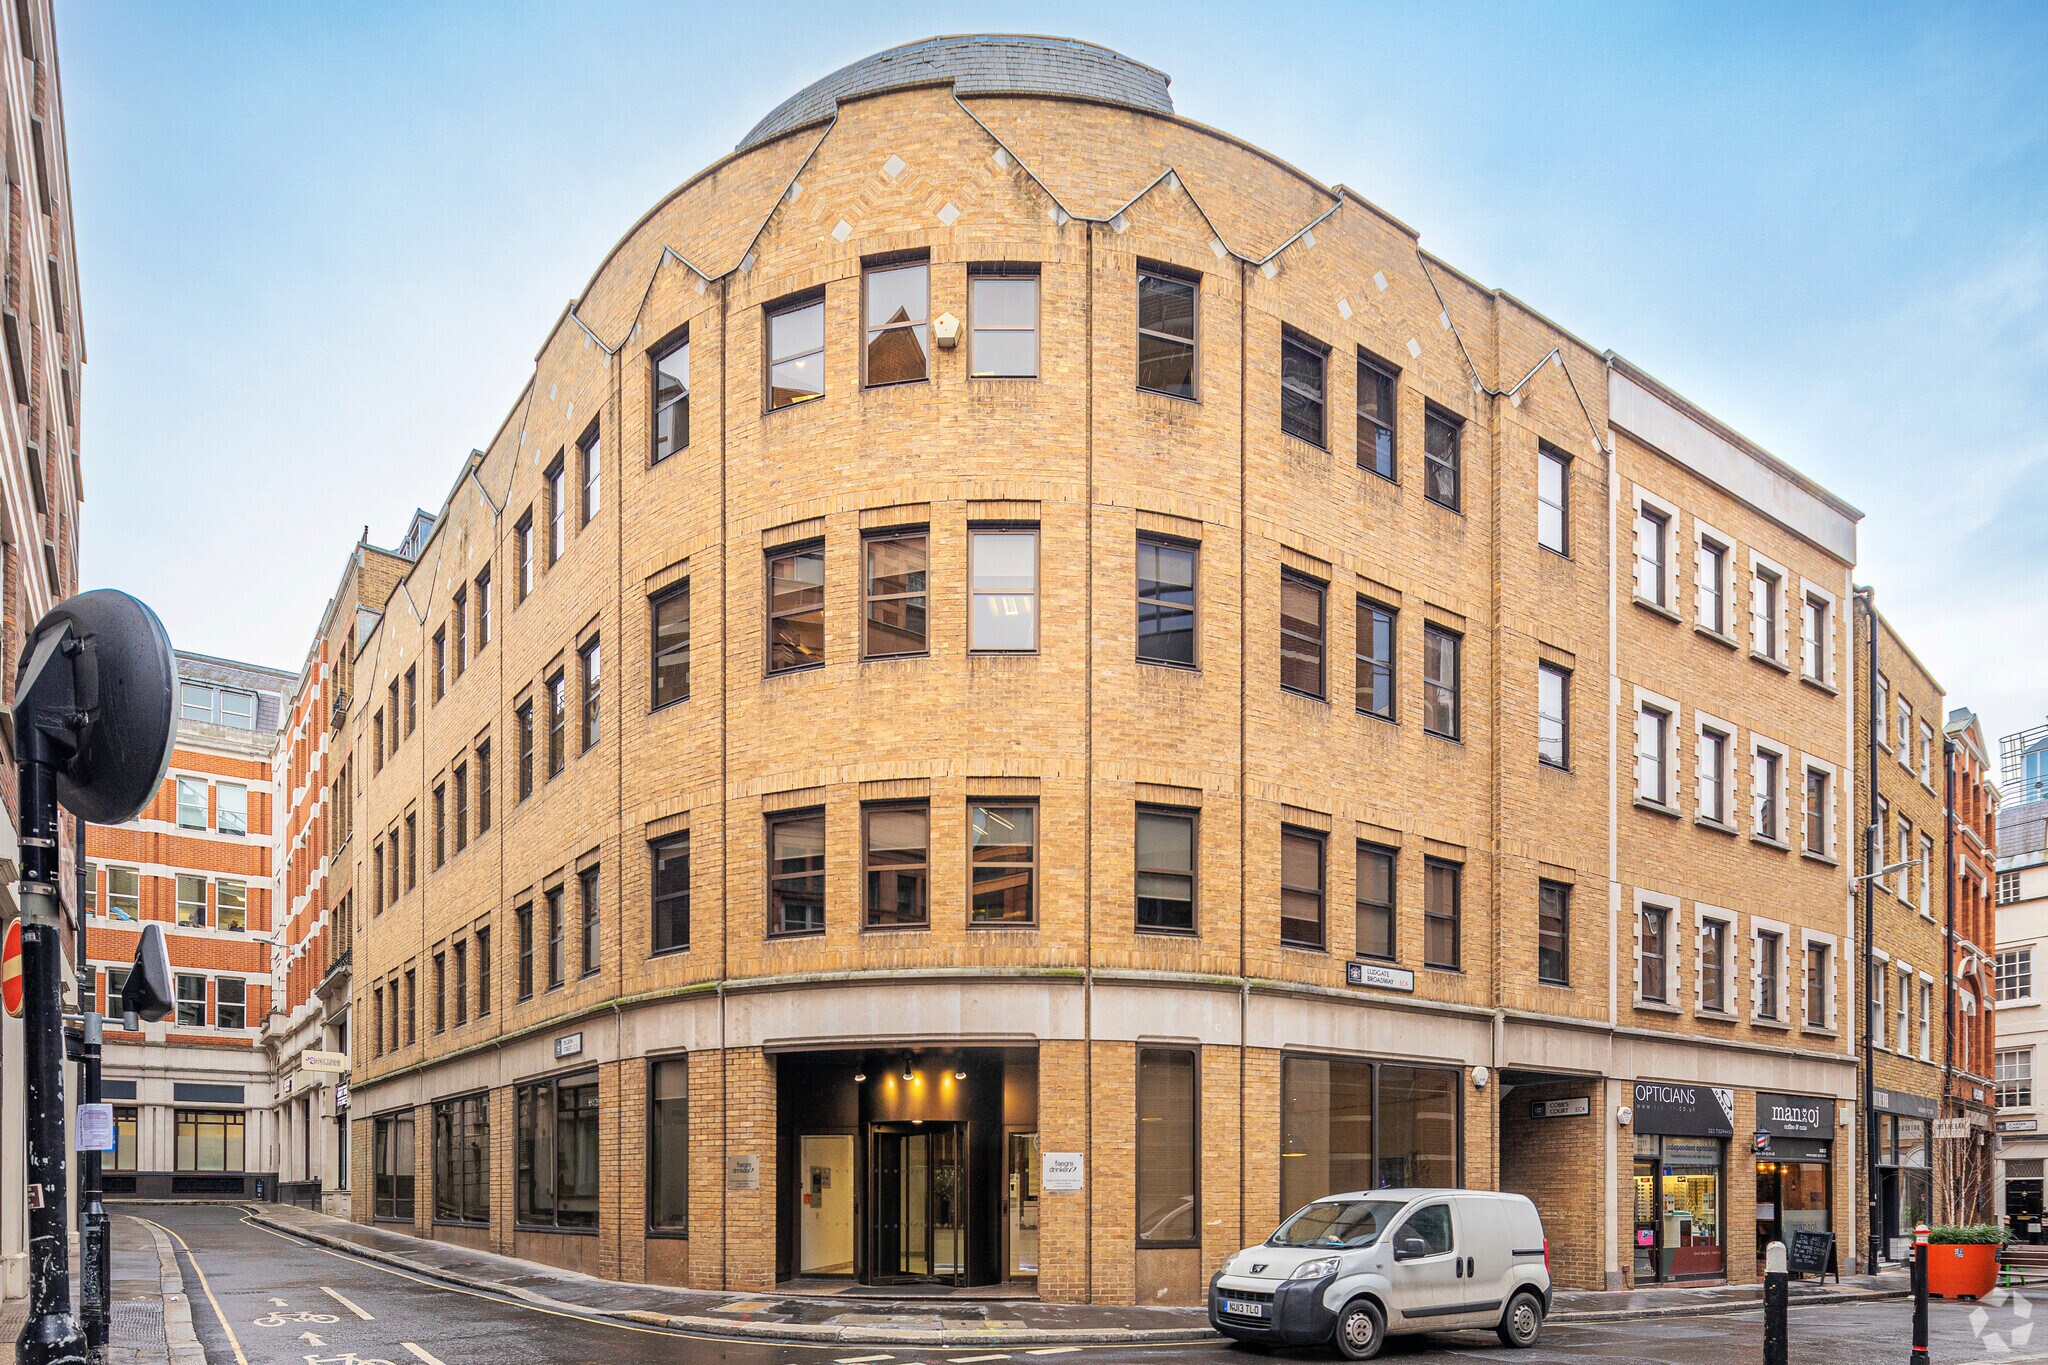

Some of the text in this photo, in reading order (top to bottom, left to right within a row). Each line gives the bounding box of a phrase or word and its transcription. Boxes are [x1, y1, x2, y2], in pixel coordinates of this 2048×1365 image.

[1367, 968, 1390, 977] LUDGATE
[1367, 975, 1394, 984] BROADWAY
[1635, 1085, 1696, 1105] OPTICIANS
[1550, 1105, 1586, 1115] COURT EC4
[1666, 1144, 1696, 1152] independent
[1696, 1144, 1718, 1153] opticians
[1055, 1160, 1074, 1168] faegre
